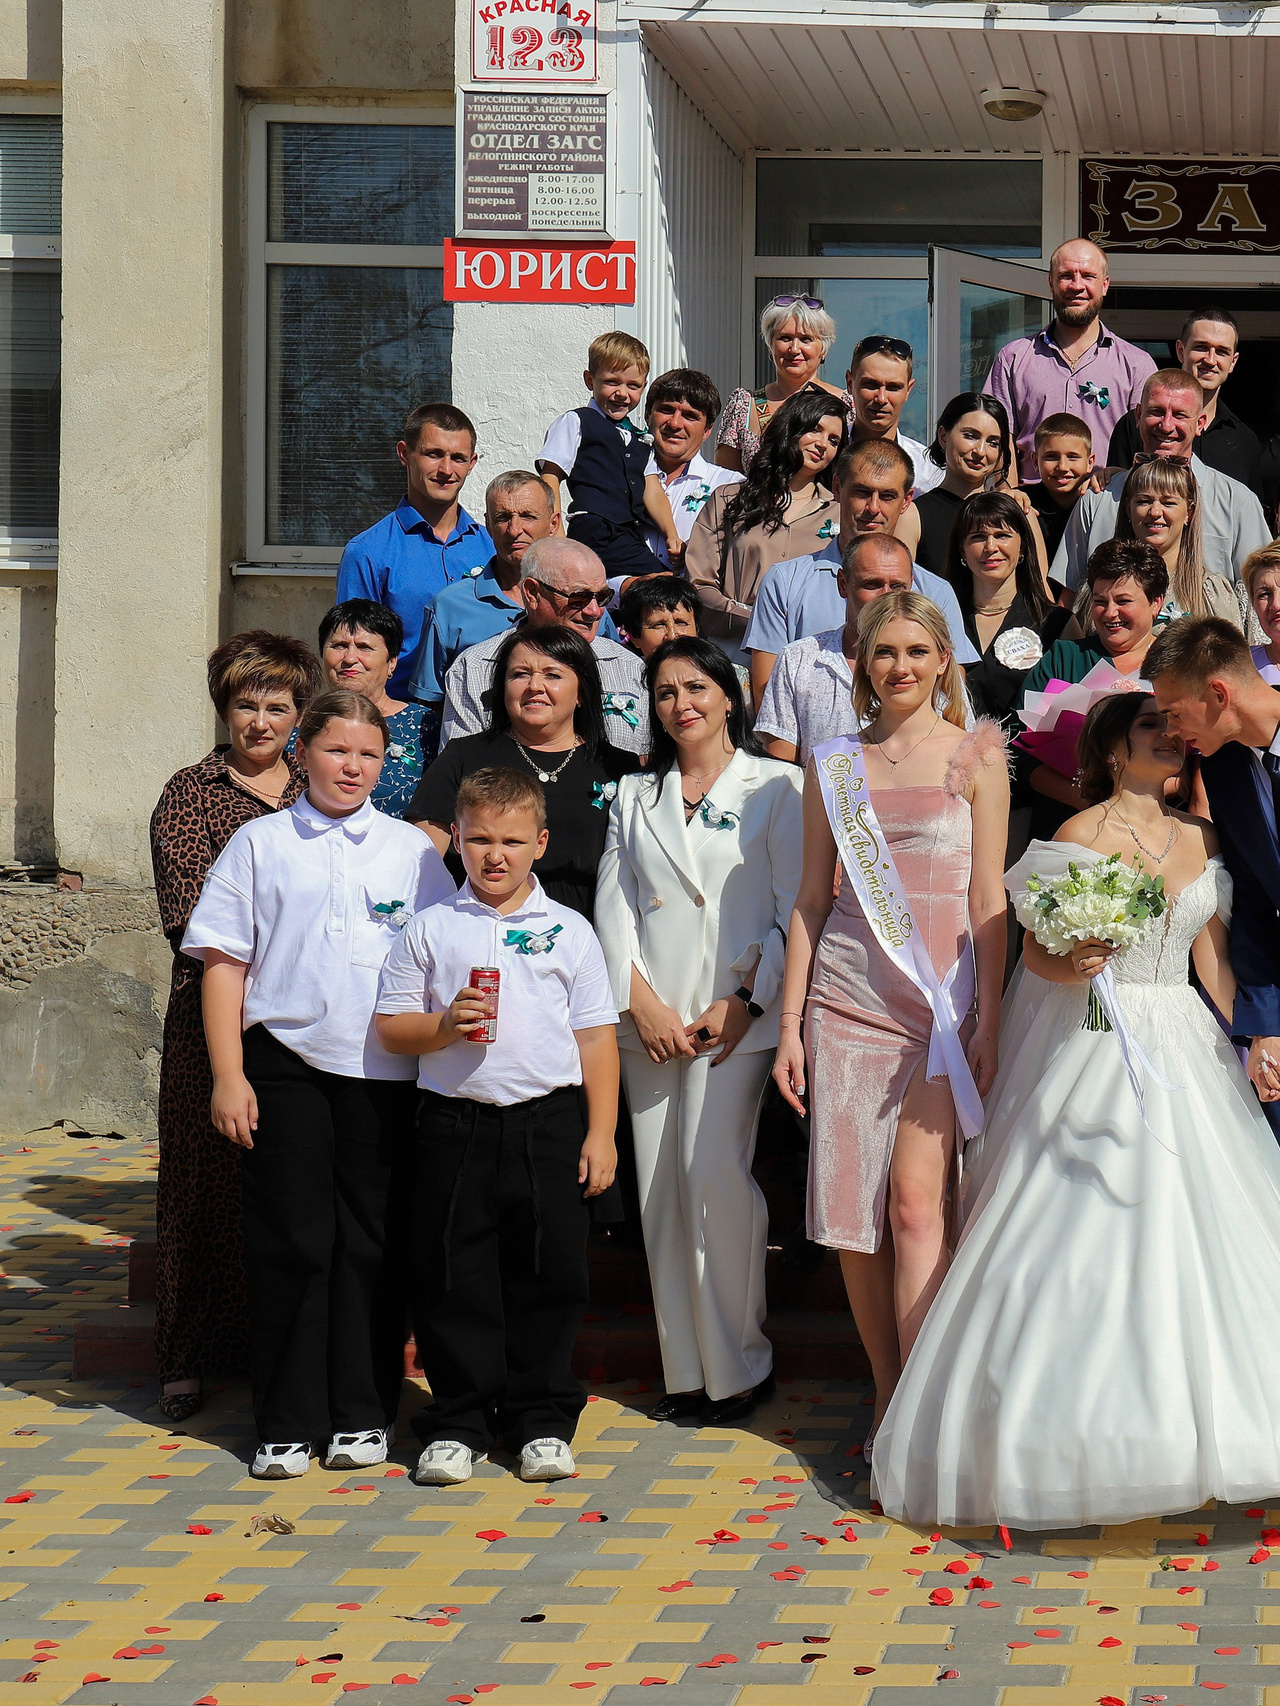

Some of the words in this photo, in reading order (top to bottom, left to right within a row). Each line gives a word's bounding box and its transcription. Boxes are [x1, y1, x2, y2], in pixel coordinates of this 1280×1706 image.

[477, 0, 592, 27] КРАСНАЯ
[486, 25, 585, 72] 123
[474, 96, 538, 104] РОССИЙСКАЯ
[541, 97, 600, 106] ФЕДЕРАЦИЯ
[467, 105, 530, 113] УПРАВЛЕНИЕ
[533, 106, 572, 114] ЗАПИСИ
[467, 113, 546, 122] ГРАЖДАНСКОГО
[548, 115, 606, 123] СОСТОЯНИЯ
[477, 123, 567, 131] КРАСНОДАРСКОГО
[470, 133, 540, 152] ОТДЕЛ
[547, 134, 603, 150] ЗАГС
[468, 152, 558, 161] БЕЛОГЛИНСКОГО
[561, 153, 605, 162] РАЙОНА
[498, 163, 533, 171] РЕЖИМ
[467, 175, 528, 184] ежедневно
[467, 186, 514, 195] пятница
[537, 186, 595, 194] 8.00-16.00
[467, 197, 516, 207] перерыв
[535, 197, 597, 206] 12.00-12.50
[467, 211, 522, 221] выходной
[531, 210, 601, 218] воскресенье
[454, 250, 636, 292] ЮРИСТ
[1007, 643, 1030, 655] СВАХА
[849, 822, 905, 949] свидетельница
